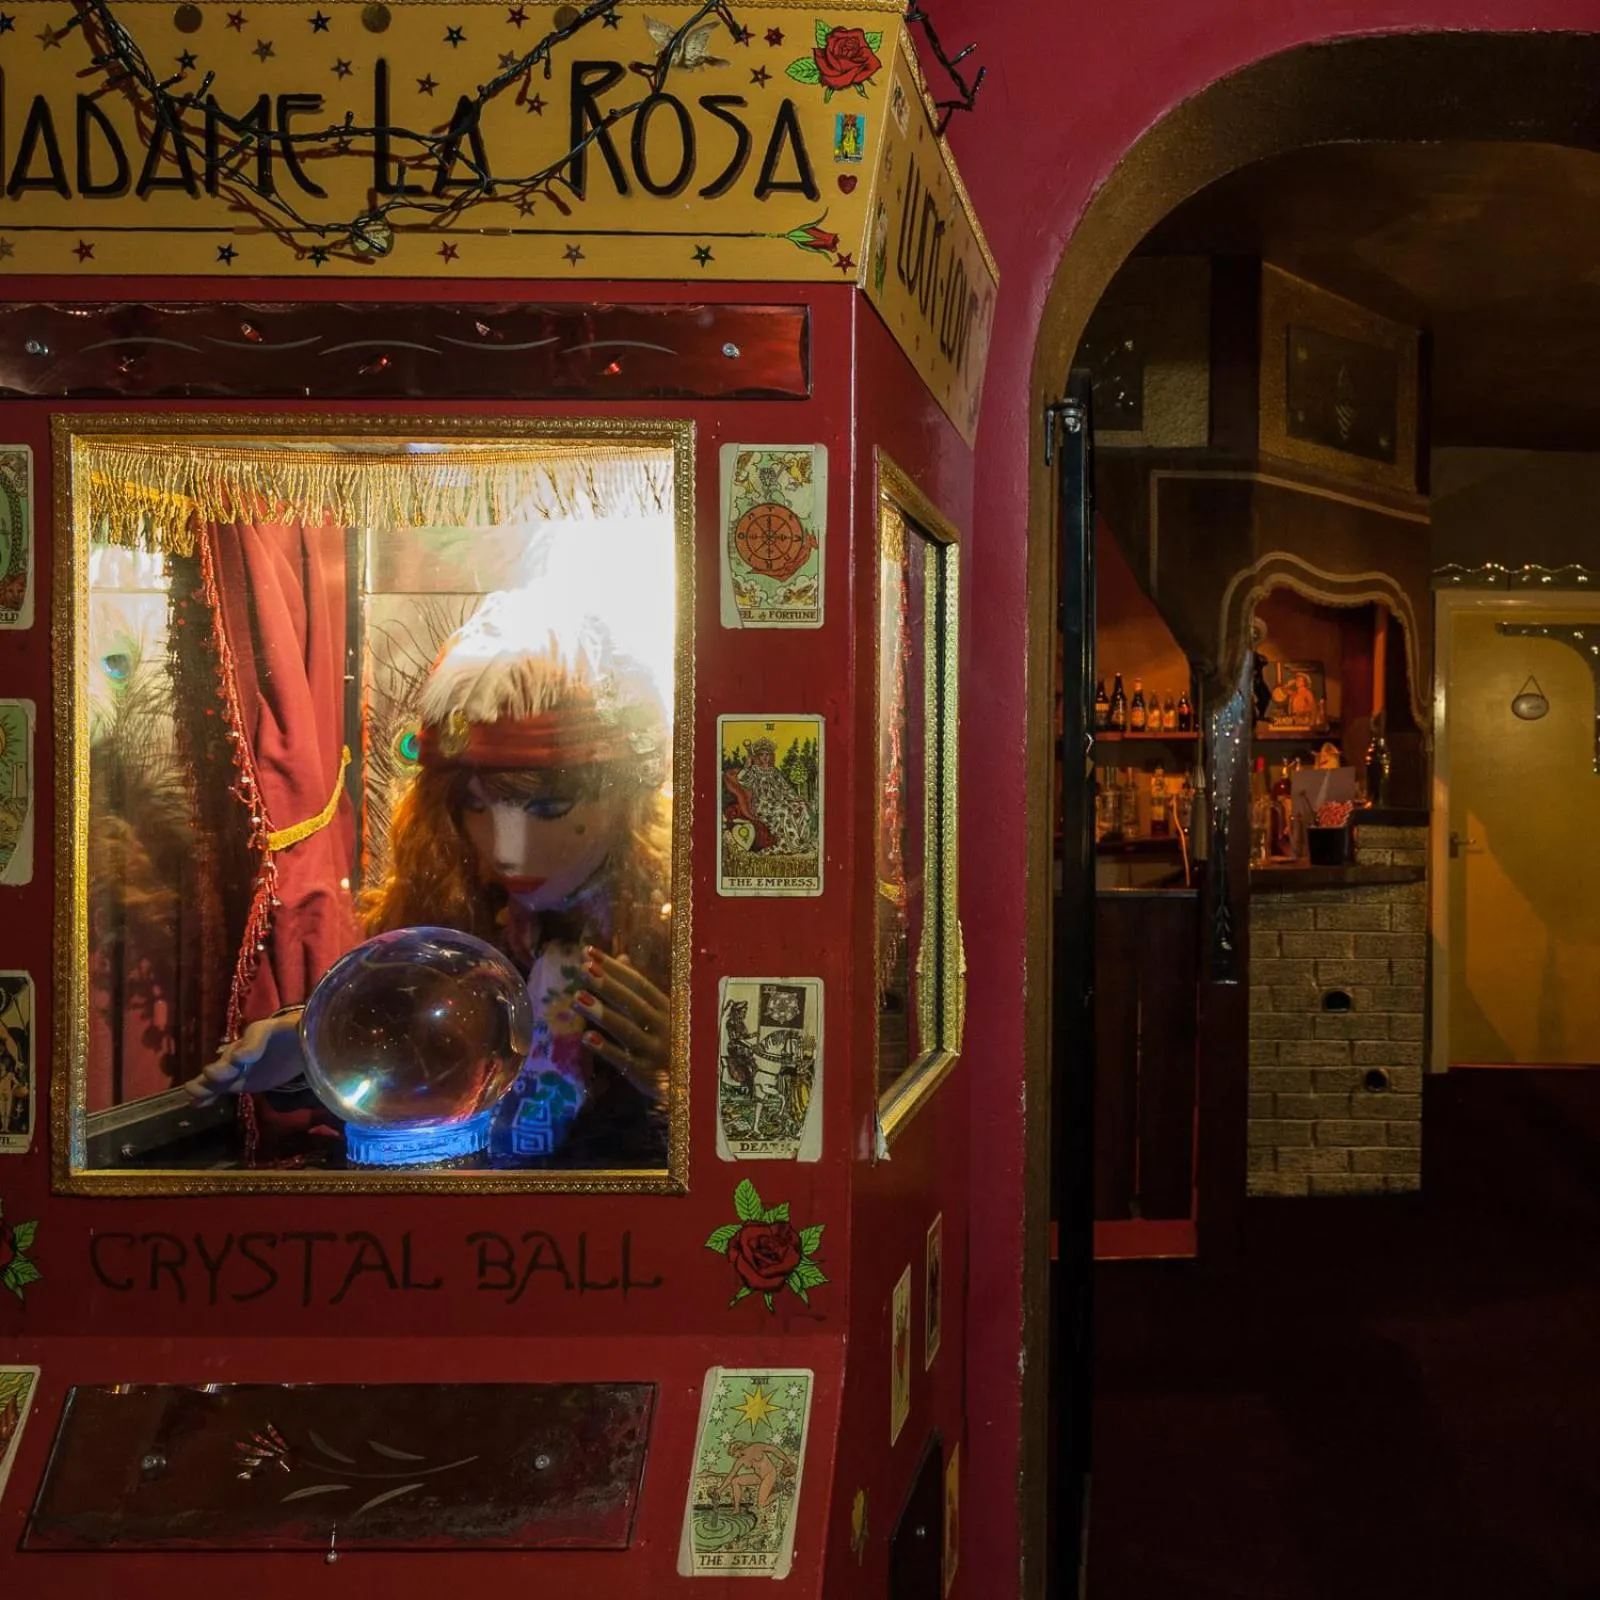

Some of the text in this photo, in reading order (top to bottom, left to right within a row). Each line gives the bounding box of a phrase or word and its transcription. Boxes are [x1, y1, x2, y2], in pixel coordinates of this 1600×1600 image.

[0, 58, 822, 202] ADAME LA ROSA
[728, 879, 753, 887] THE
[89, 1229, 664, 1306] CRYSTAL BALL
[699, 1554, 723, 1566] THE
